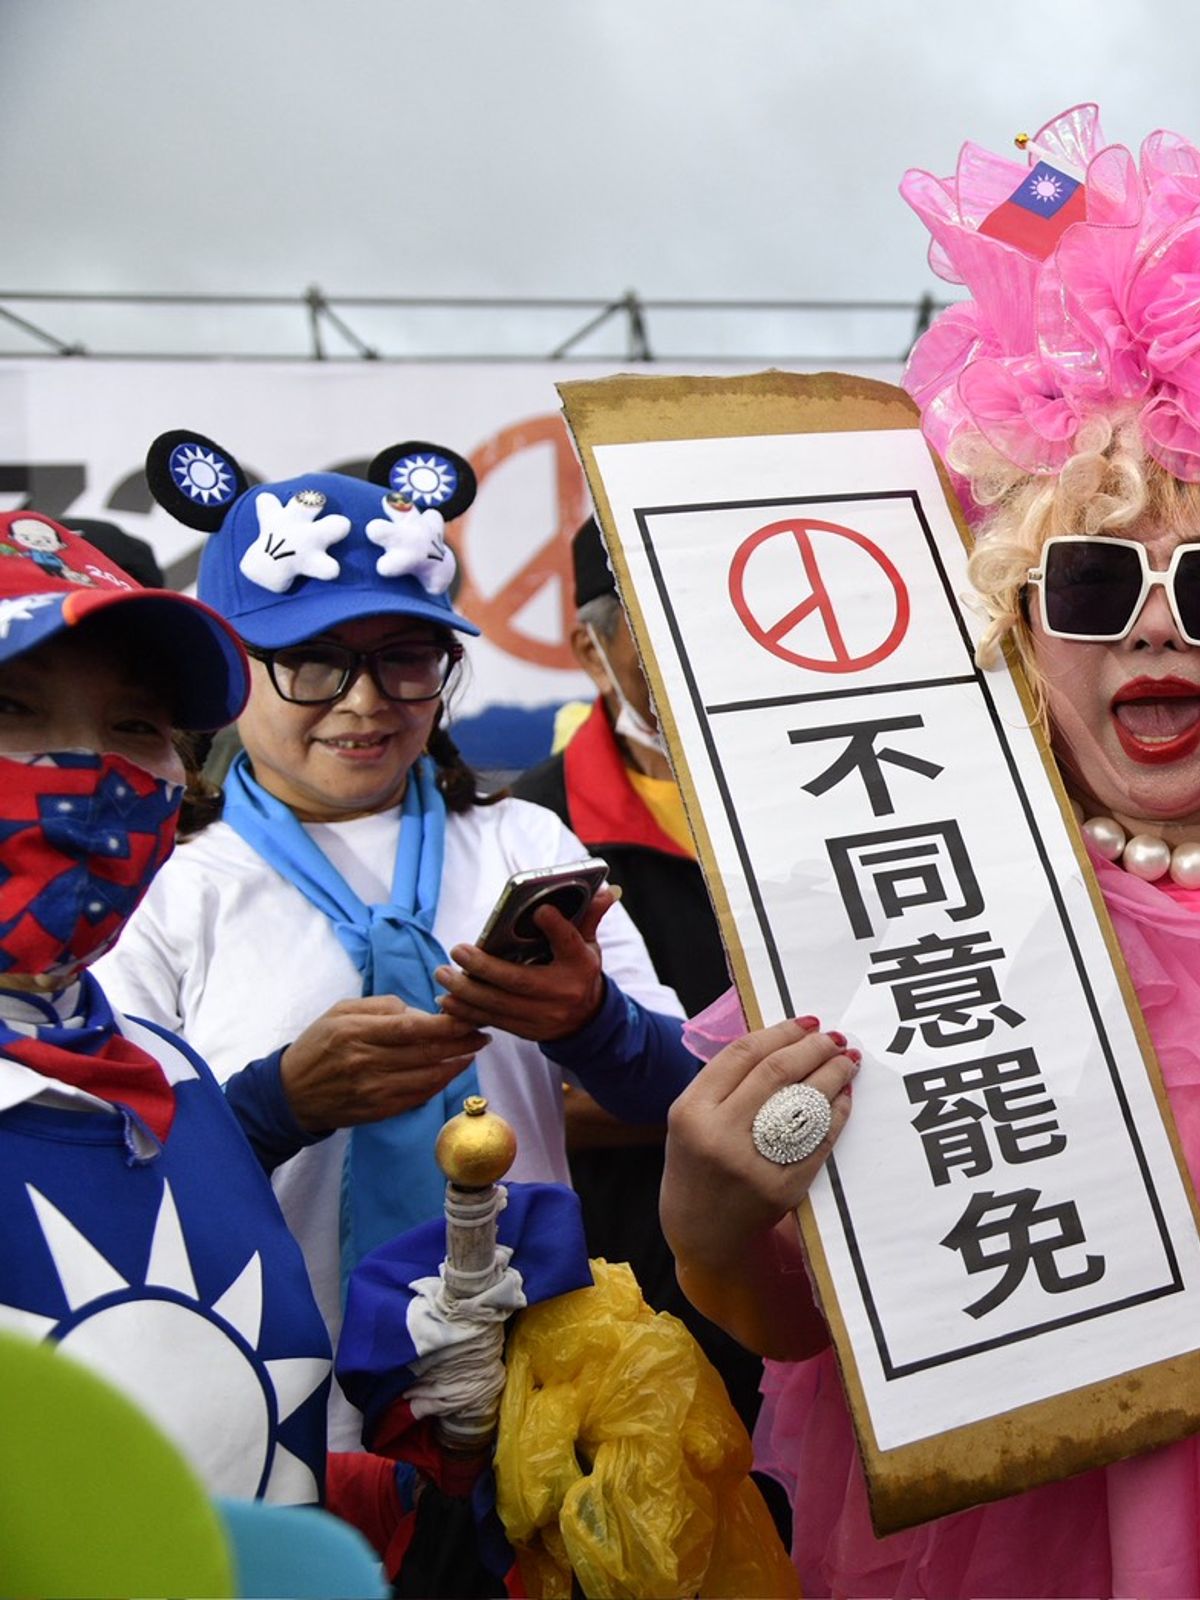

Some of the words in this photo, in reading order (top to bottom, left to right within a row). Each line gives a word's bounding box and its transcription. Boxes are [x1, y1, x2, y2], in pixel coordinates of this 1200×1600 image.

[788, 714, 1106, 1319] 不同意罷免
